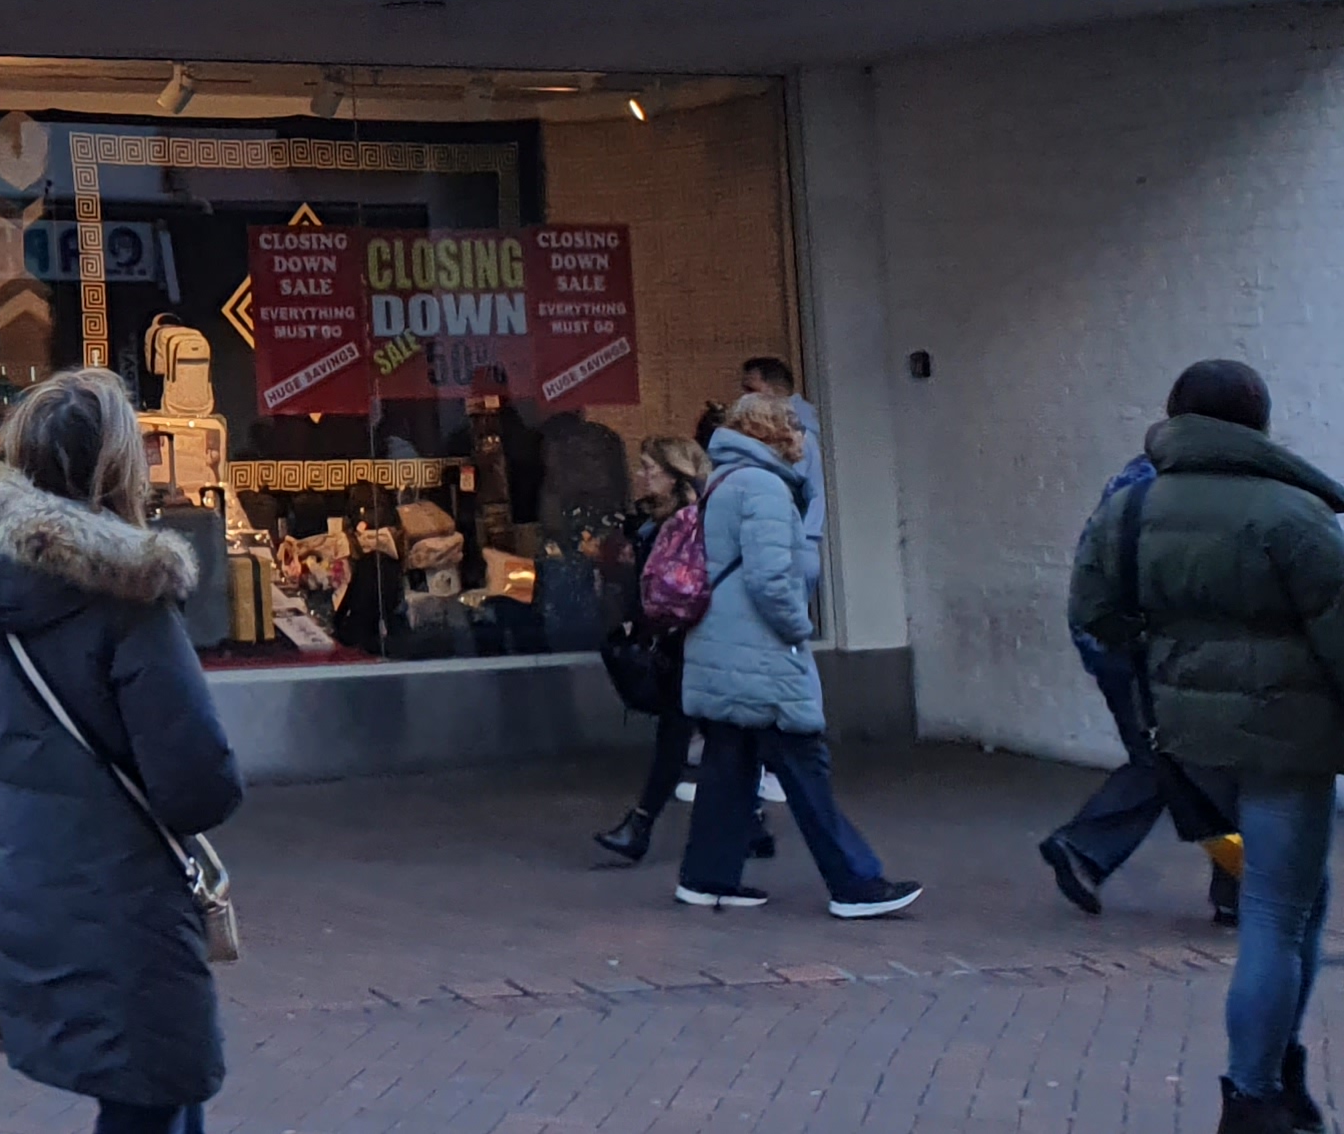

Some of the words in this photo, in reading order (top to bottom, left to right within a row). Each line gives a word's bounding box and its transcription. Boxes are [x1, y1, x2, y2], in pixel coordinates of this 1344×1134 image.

[258, 232, 348, 251] CLOSING
[536, 230, 620, 249] CLOSING
[273, 255, 338, 273] DOWN
[366, 237, 525, 290] CLOSING
[550, 253, 610, 270] DOWN
[280, 278, 334, 296] SALE
[556, 274, 607, 292] SALE
[260, 305, 356, 321] EVERYTHING
[372, 292, 528, 337] DOWN
[538, 302, 627, 317] EVERYTHING
[274, 325, 317, 339] MUST
[321, 324, 343, 339] GO
[551, 320, 590, 334] MUST
[593, 320, 615, 334] GO
[373, 328, 422, 376] SALE
[266, 375, 304, 405] HUGE
[306, 345, 357, 383] SAVINGS
